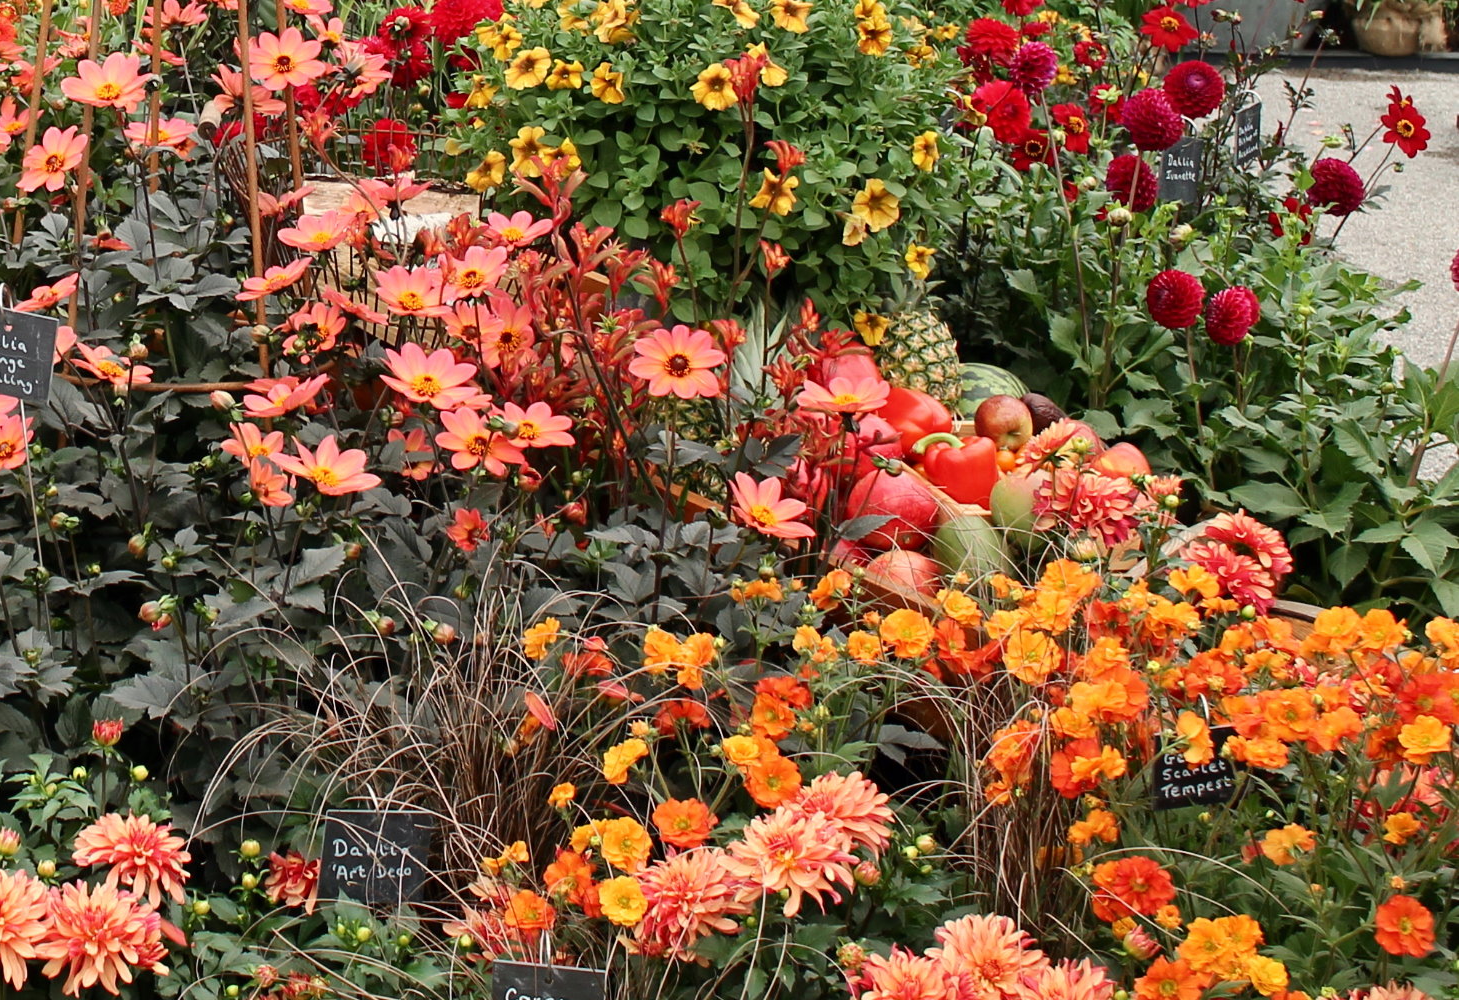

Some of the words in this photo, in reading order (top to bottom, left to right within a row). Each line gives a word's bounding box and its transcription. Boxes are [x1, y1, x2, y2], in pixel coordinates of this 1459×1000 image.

[1167, 153, 1195, 168] Dahlia
[1162, 759, 1227, 781] Scarlet
[1160, 775, 1233, 799] Tempest
[376, 863, 413, 879] Deco
